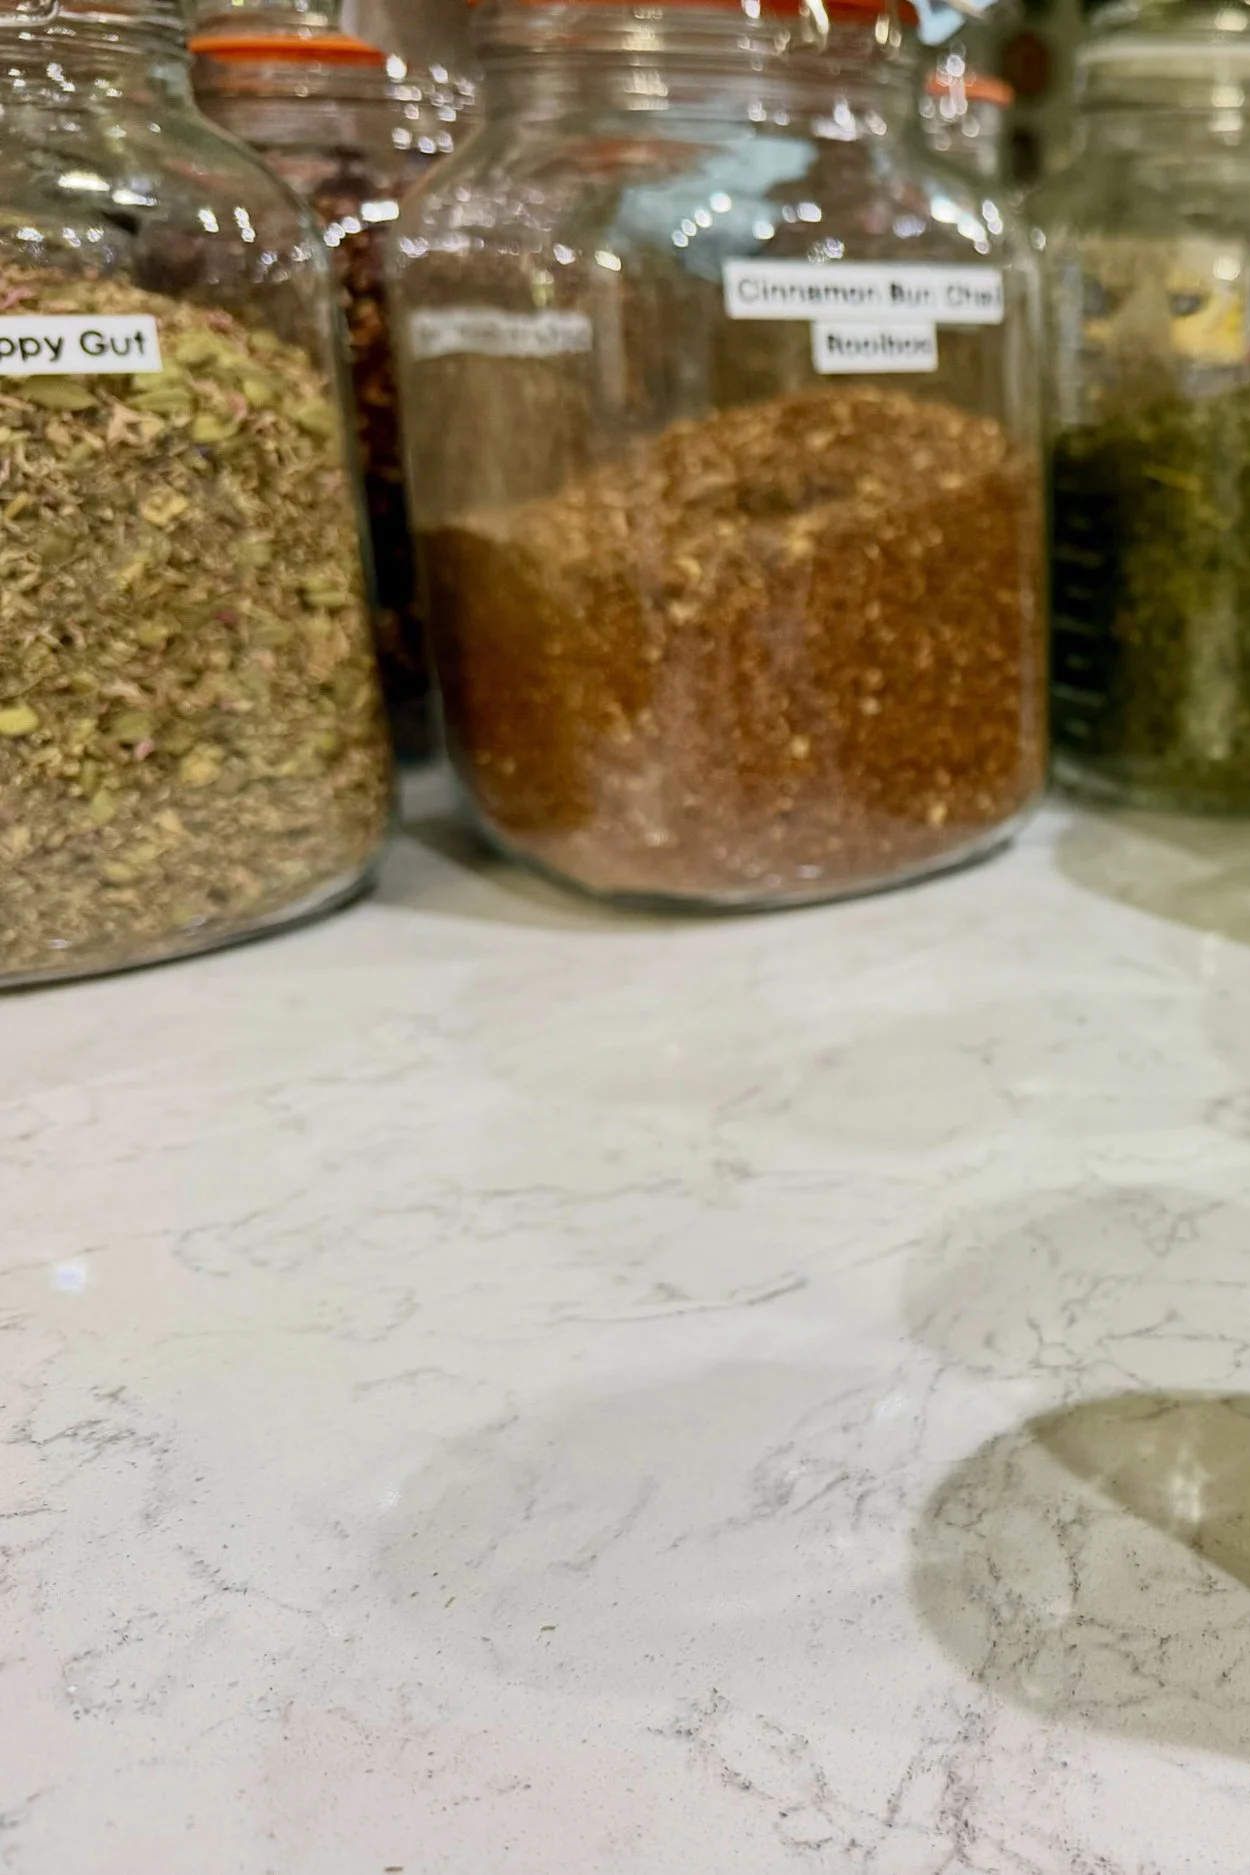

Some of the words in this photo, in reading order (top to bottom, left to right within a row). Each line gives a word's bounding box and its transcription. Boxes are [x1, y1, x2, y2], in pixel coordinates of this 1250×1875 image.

[737, 278, 882, 303] Cinnamon
[889, 281, 931, 304] Bun
[79, 329, 145, 357] Gut
